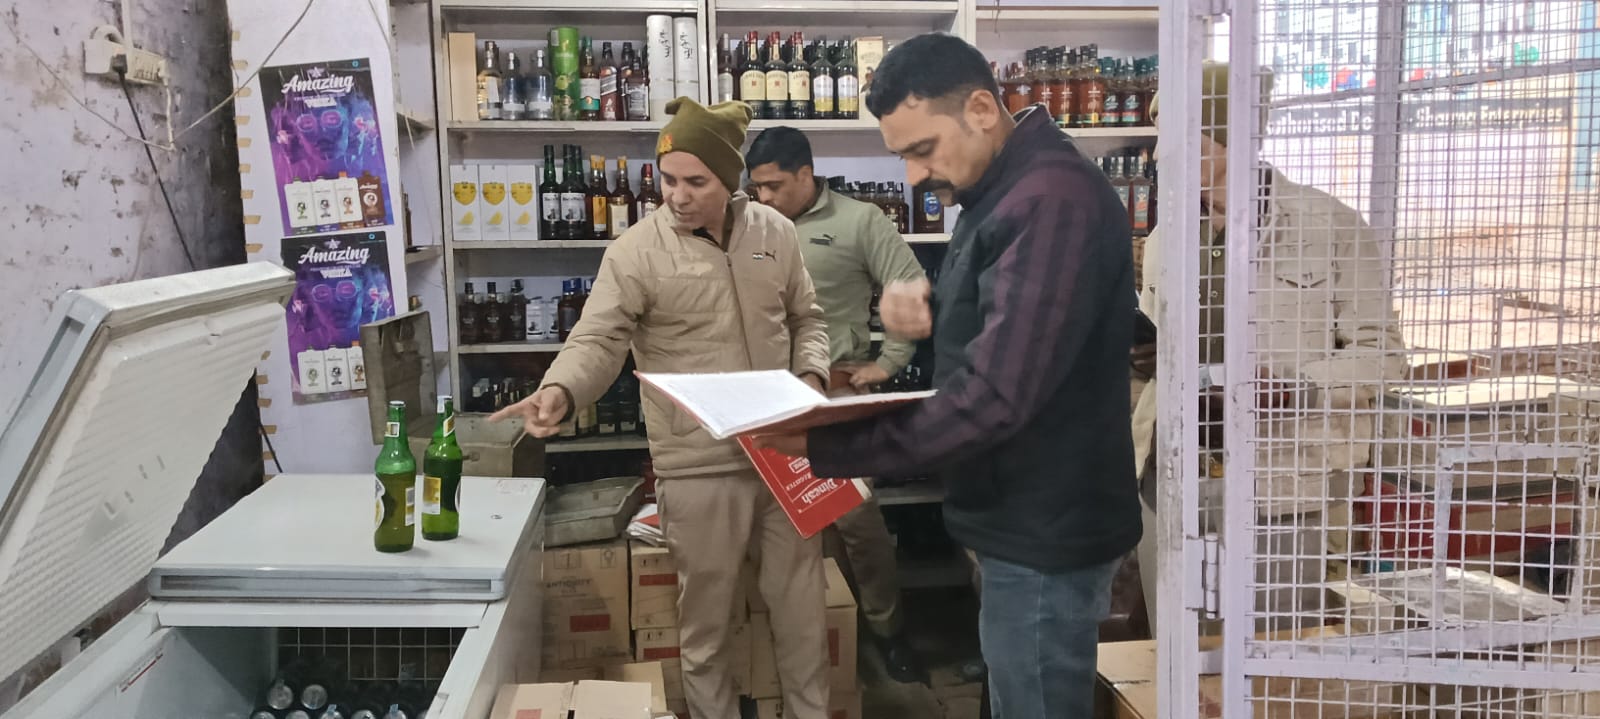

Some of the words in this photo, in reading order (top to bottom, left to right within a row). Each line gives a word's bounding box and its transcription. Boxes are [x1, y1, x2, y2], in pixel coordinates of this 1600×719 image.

[281, 74, 354, 94] Amazing
[298, 246, 370, 265] Amazing
[801, 478, 839, 504] Dinesh
